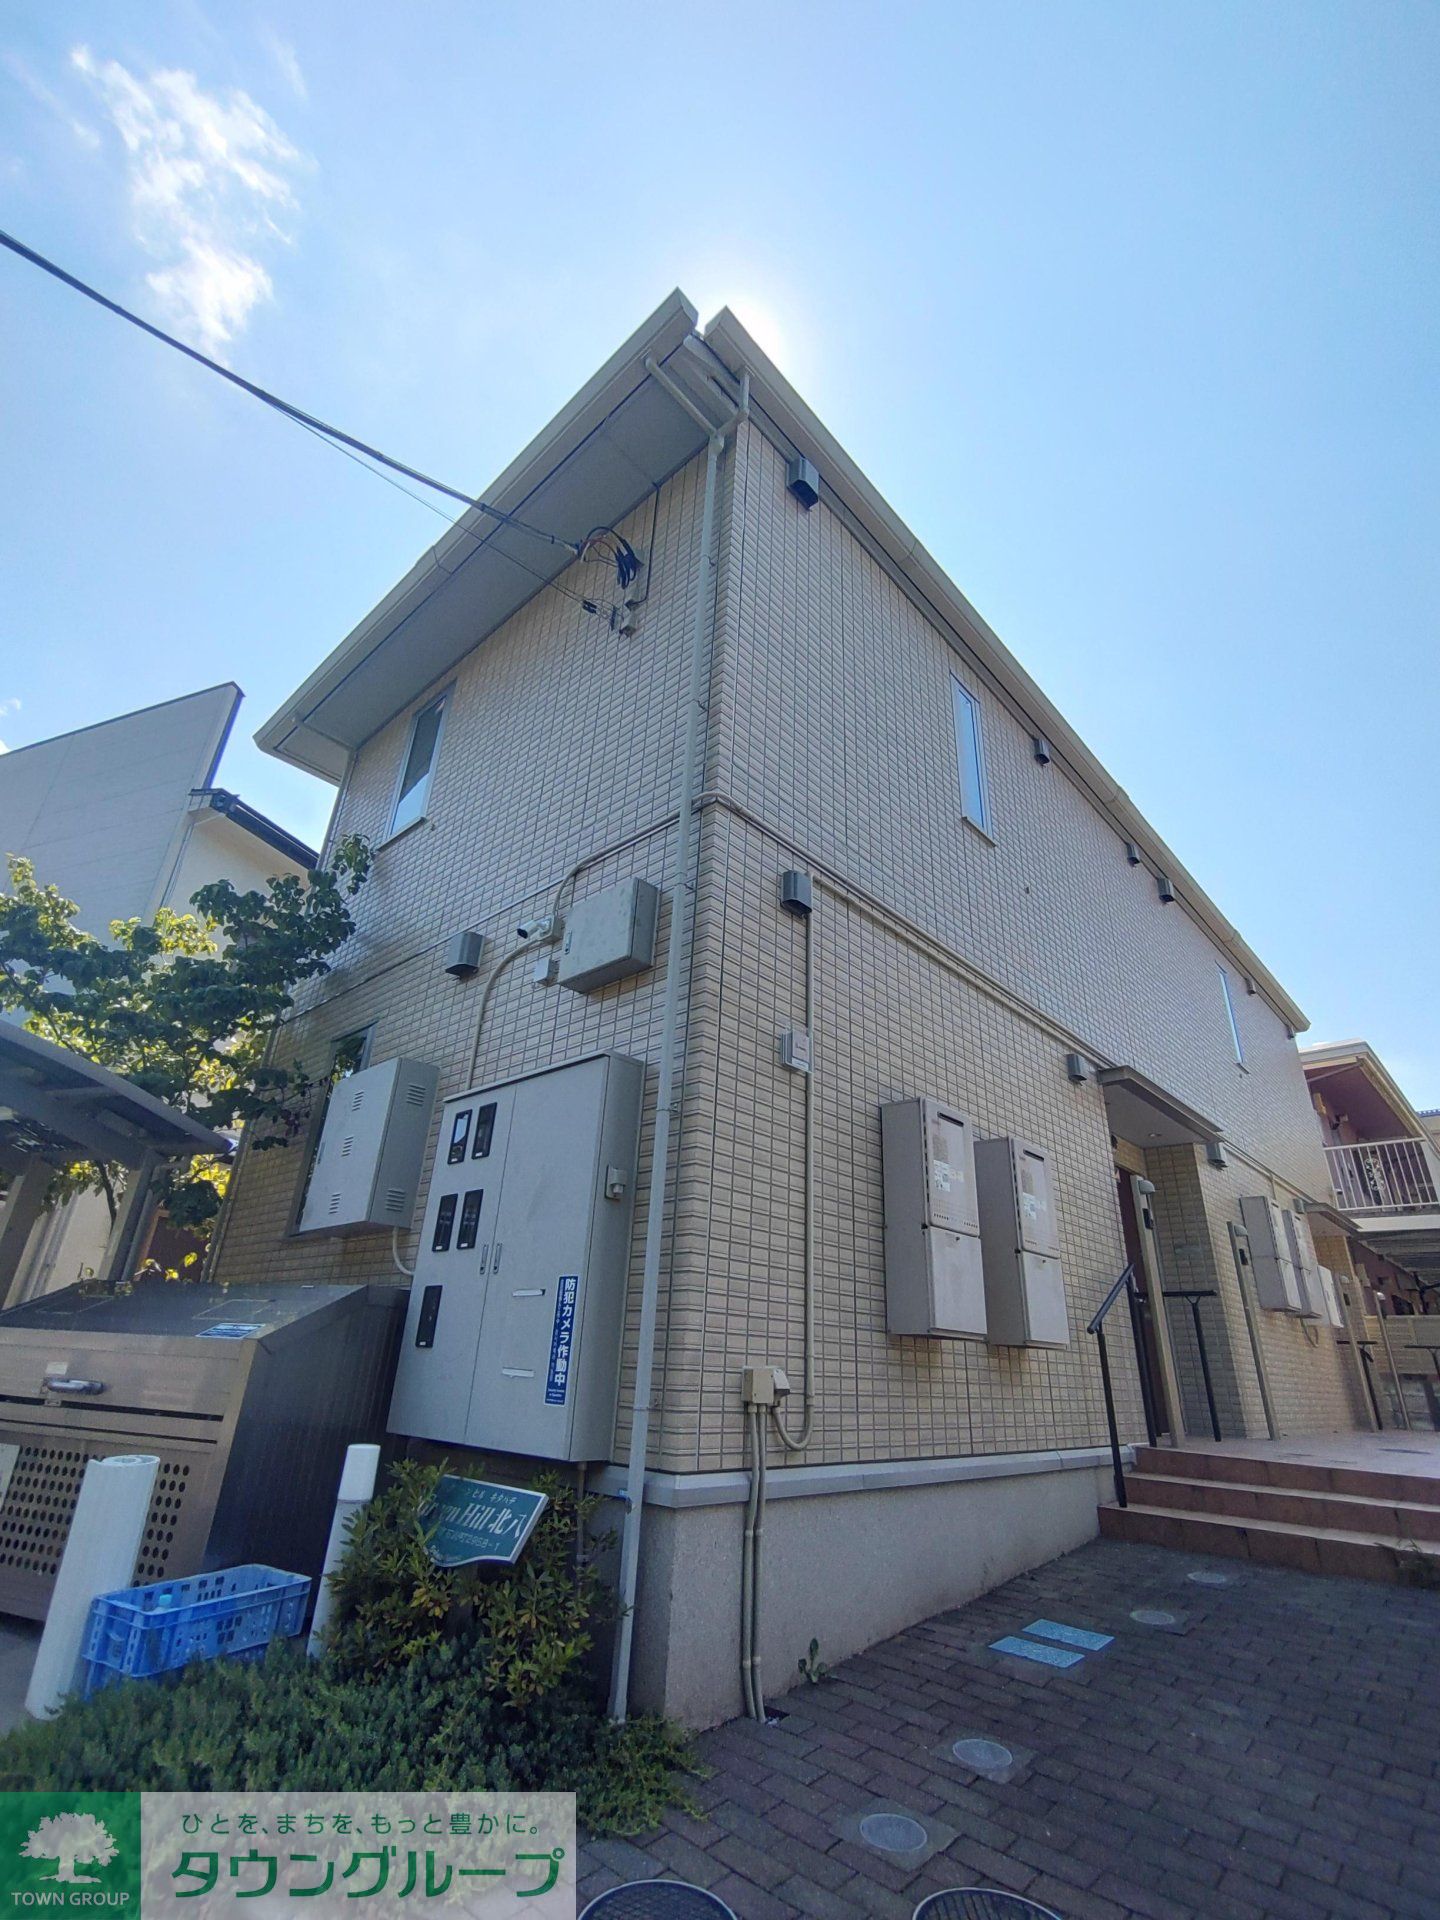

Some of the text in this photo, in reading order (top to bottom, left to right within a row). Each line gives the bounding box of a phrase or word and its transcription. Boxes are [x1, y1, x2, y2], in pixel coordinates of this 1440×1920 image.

[554, 1278, 577, 1386] 防犯カメラ作動中
[456, 1502, 496, 1531] Hill
[488, 1507, 528, 1538] 北八
